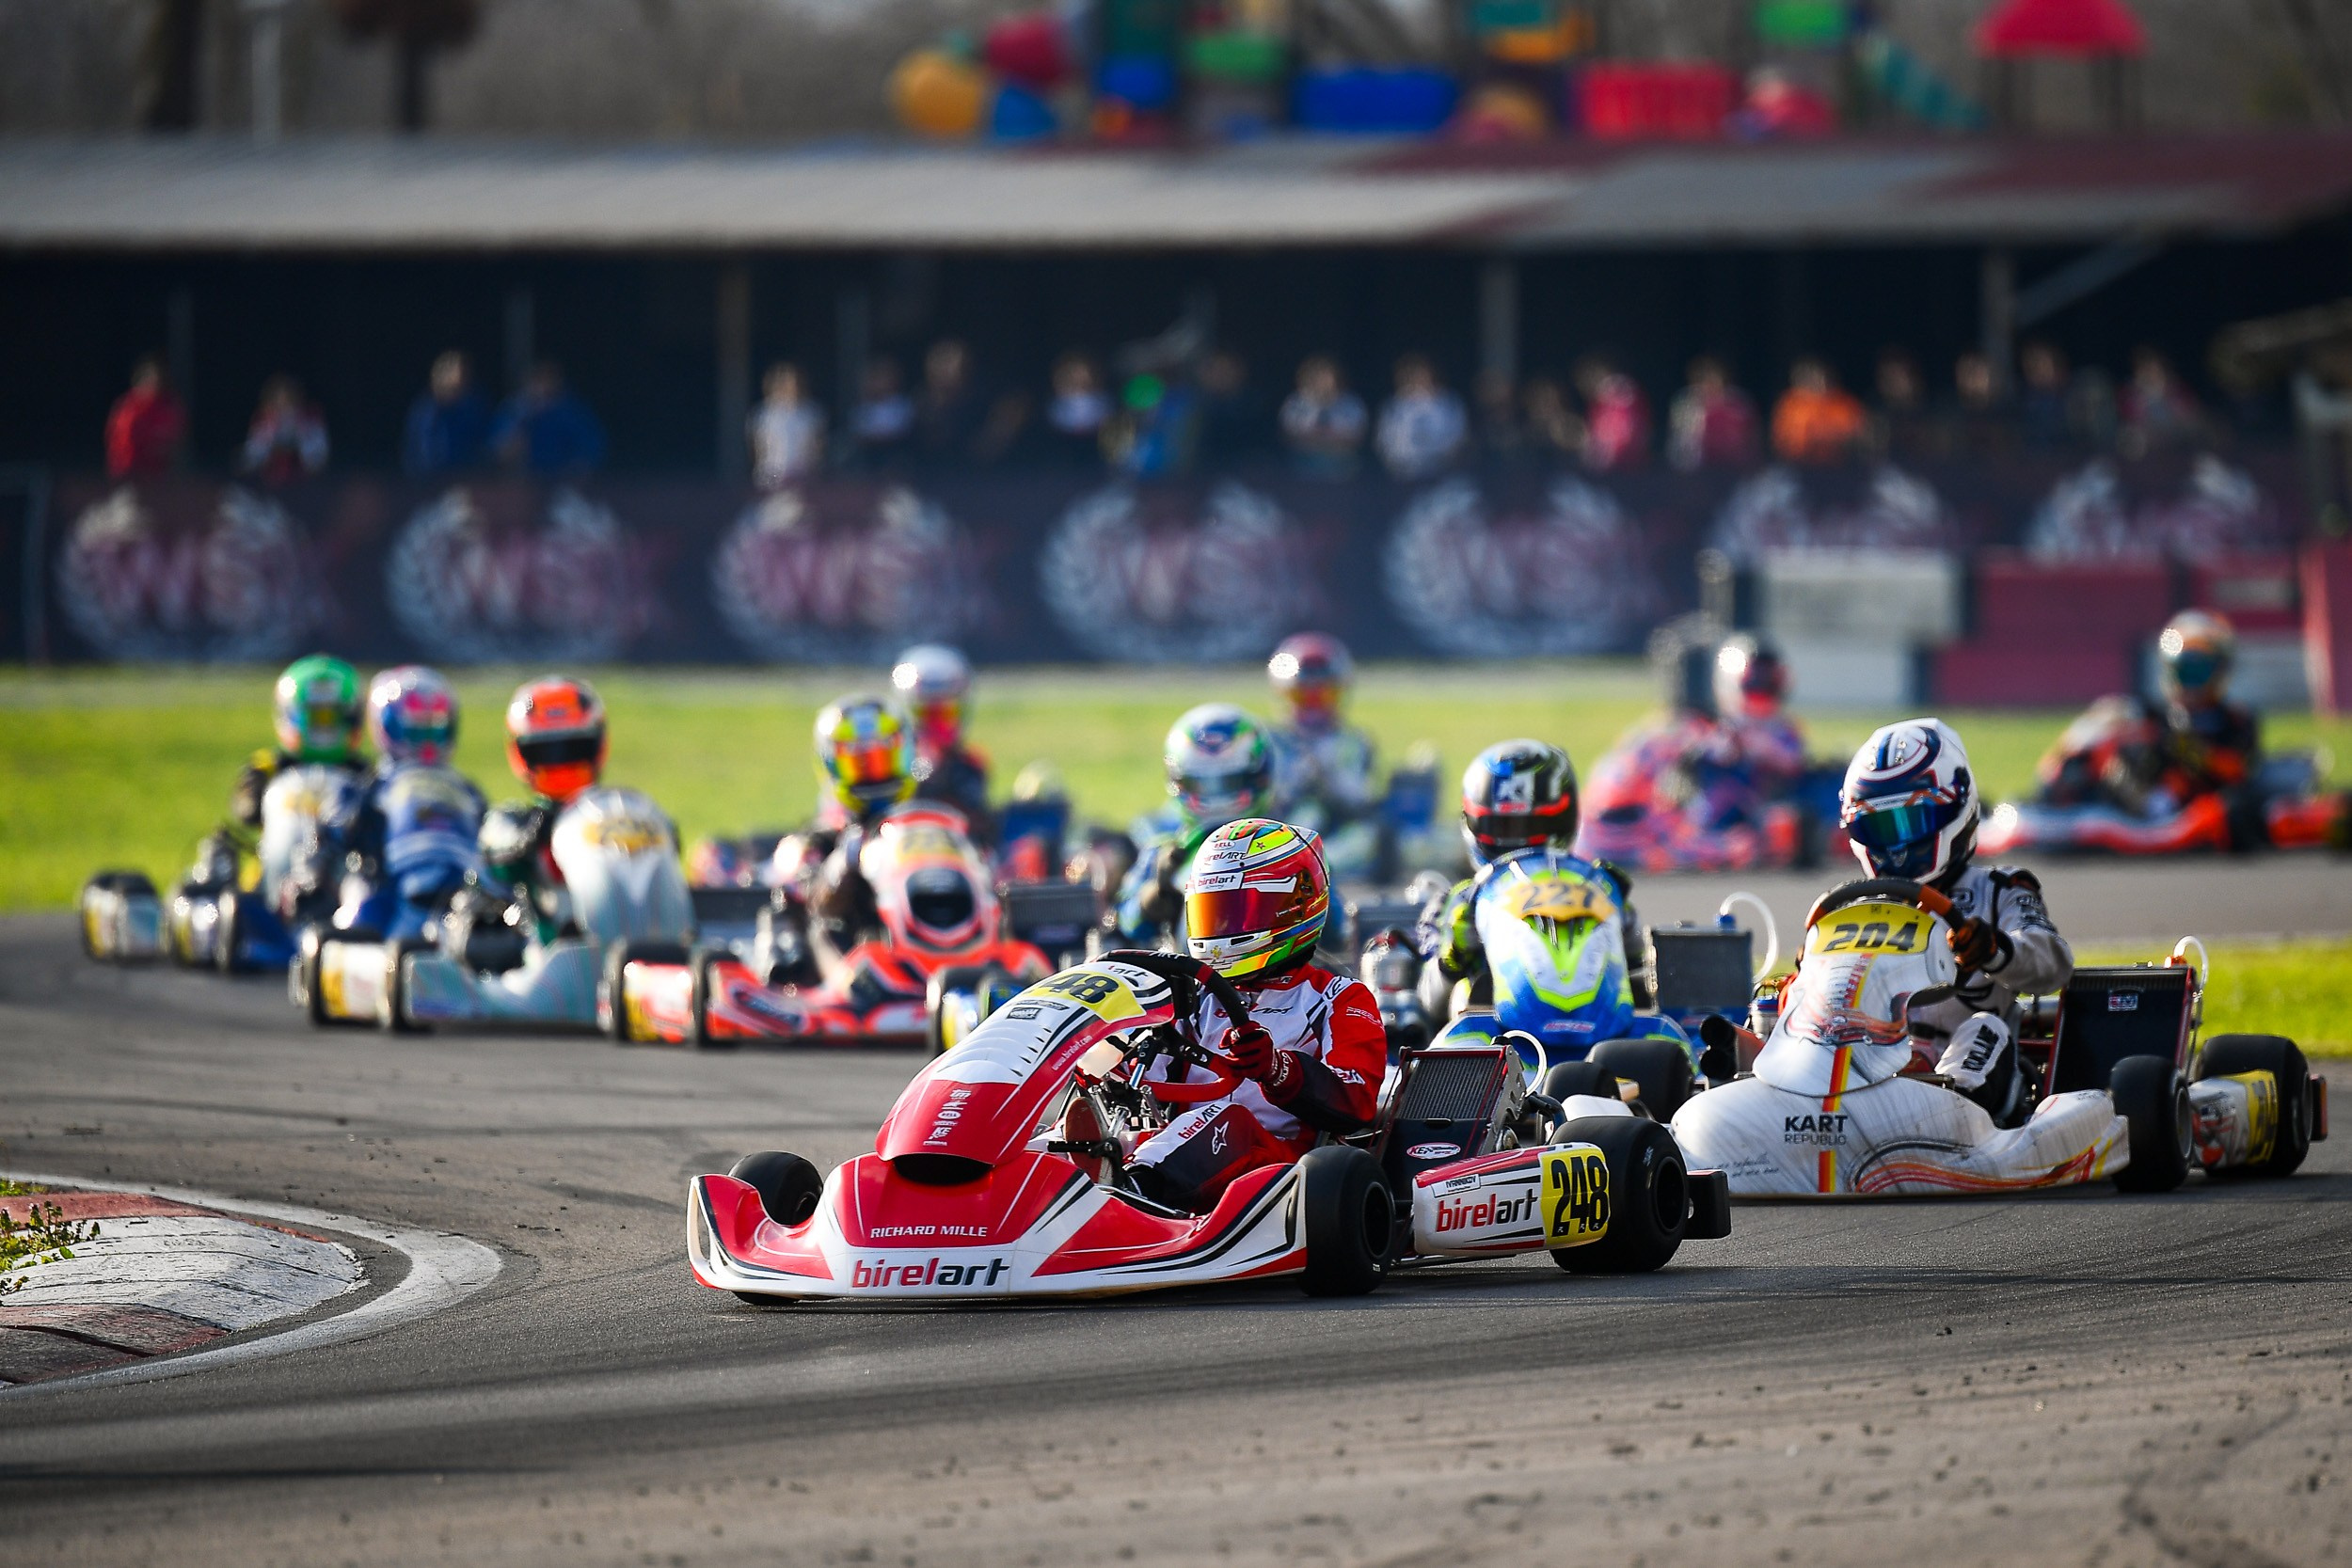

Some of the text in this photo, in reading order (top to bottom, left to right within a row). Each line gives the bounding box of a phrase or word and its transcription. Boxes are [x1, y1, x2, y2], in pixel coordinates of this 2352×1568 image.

[1199, 876, 1236, 886] birelart
[1822, 922, 1919, 952] 204
[1035, 972, 1120, 1004] 48
[1178, 1103, 1222, 1140] birelART
[1784, 1115, 1849, 1132] KART
[1784, 1132, 1848, 1146] REPUBLIC
[1436, 1188, 1539, 1232] birelart
[1550, 1155, 1609, 1237] 248
[870, 1226, 988, 1239] RICHARD MILLE
[851, 1257, 1010, 1289] birelart
